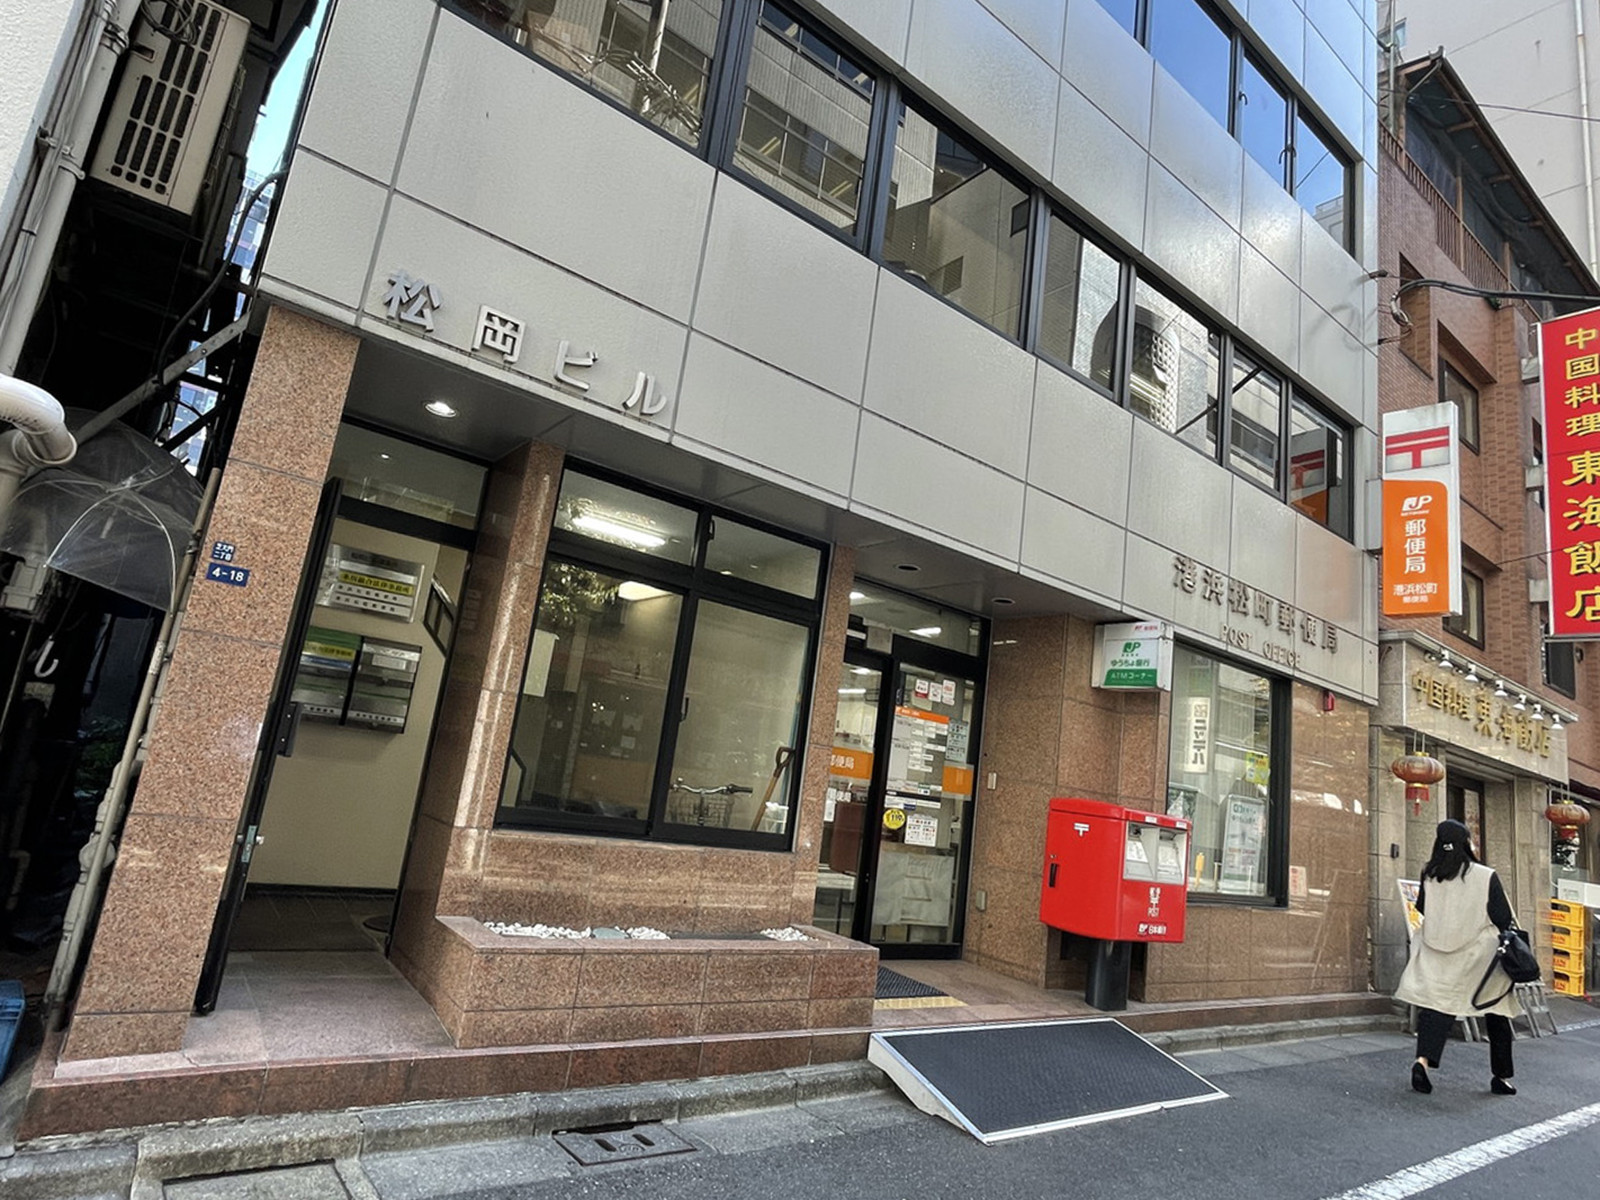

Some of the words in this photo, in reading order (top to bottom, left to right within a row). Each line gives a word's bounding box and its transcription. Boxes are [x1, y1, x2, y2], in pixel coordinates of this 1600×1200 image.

[384, 269, 667, 416] 松岡ビル
[1564, 327, 1600, 437] 中国料理
[1404, 519, 1426, 574] 郵便局
[212, 567, 245, 582] 4-18
[1393, 582, 1438, 596] 港浜松町
[1173, 555, 1338, 654] 港浜松町郵便局
[1220, 624, 1252, 650] POST
[1263, 641, 1300, 667] OFFICE
